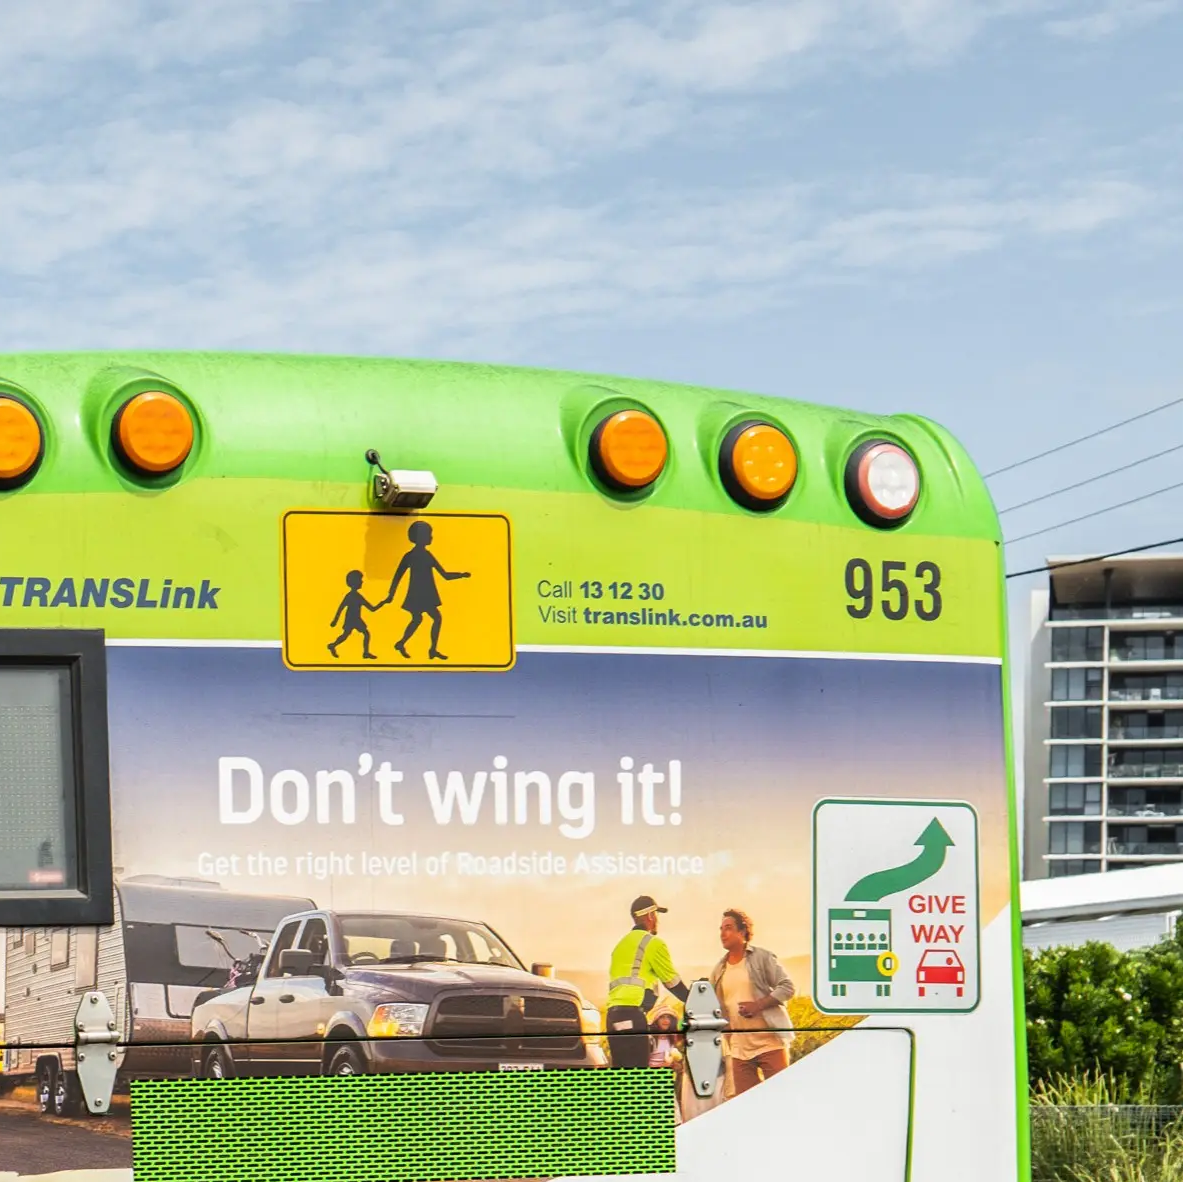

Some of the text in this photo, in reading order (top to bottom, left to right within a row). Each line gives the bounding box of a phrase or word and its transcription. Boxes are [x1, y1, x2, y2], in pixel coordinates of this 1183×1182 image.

[0, 576, 222, 610] TRANSLink
[537, 580, 665, 601] Call 13 12 30
[843, 557, 943, 622] 953
[538, 605, 768, 628] Visit translink.com.au
[217, 752, 683, 840] Don't wing it!
[198, 852, 704, 880] Get the right level of Roadside Assistance
[908, 895, 966, 914] GIVE
[911, 924, 965, 943] WAY
